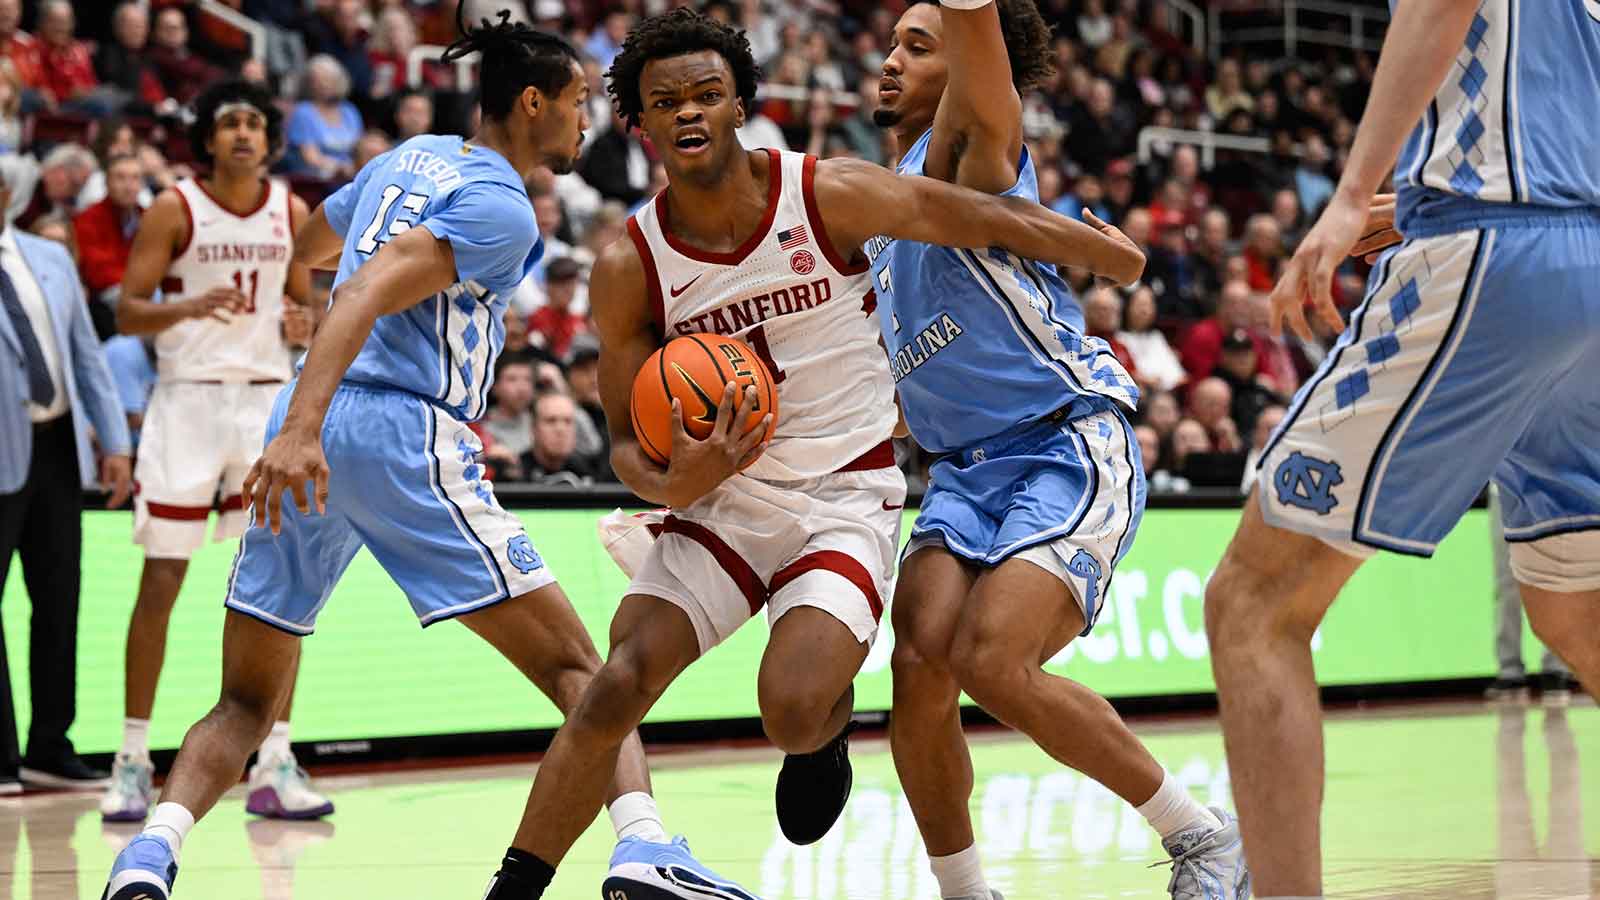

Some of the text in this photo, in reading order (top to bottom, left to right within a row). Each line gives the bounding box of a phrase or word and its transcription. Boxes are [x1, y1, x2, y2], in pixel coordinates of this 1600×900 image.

[355, 183, 430, 255] 15
[197, 243, 288, 263] STANFORD
[673, 277, 832, 337] STANFORD
[744, 323, 787, 385] 1
